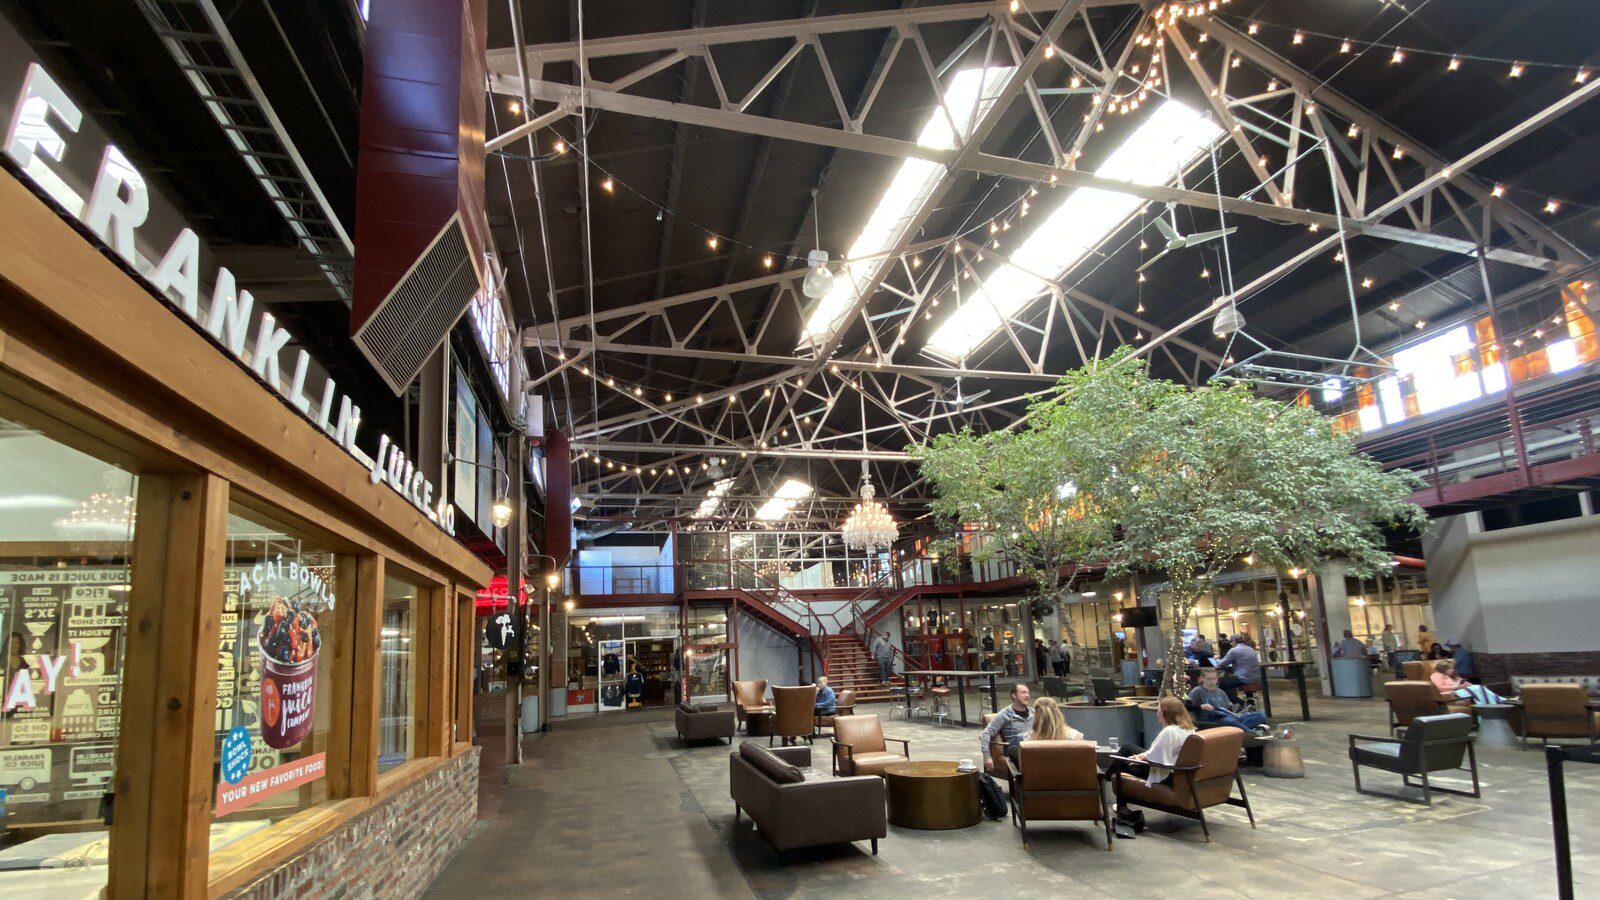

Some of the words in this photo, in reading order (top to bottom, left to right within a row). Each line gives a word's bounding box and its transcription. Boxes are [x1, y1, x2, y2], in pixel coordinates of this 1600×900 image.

[4, 62, 361, 452] FRANKLIN
[370, 433, 434, 515] JUICE
[240, 552, 282, 596] AÇAÍ
[290, 561, 336, 611] BOWLS
[283, 676, 313, 695] FRANKLIN
[287, 709, 310, 729] COMPANY
[227, 748, 249, 772] SHOCK
[228, 741, 247, 760] BOWL
[222, 787, 248, 804] YOUR
[249, 778, 269, 795] NEW
[270, 767, 304, 787] FAVORITE
[304, 761, 324, 775] FOOD!
